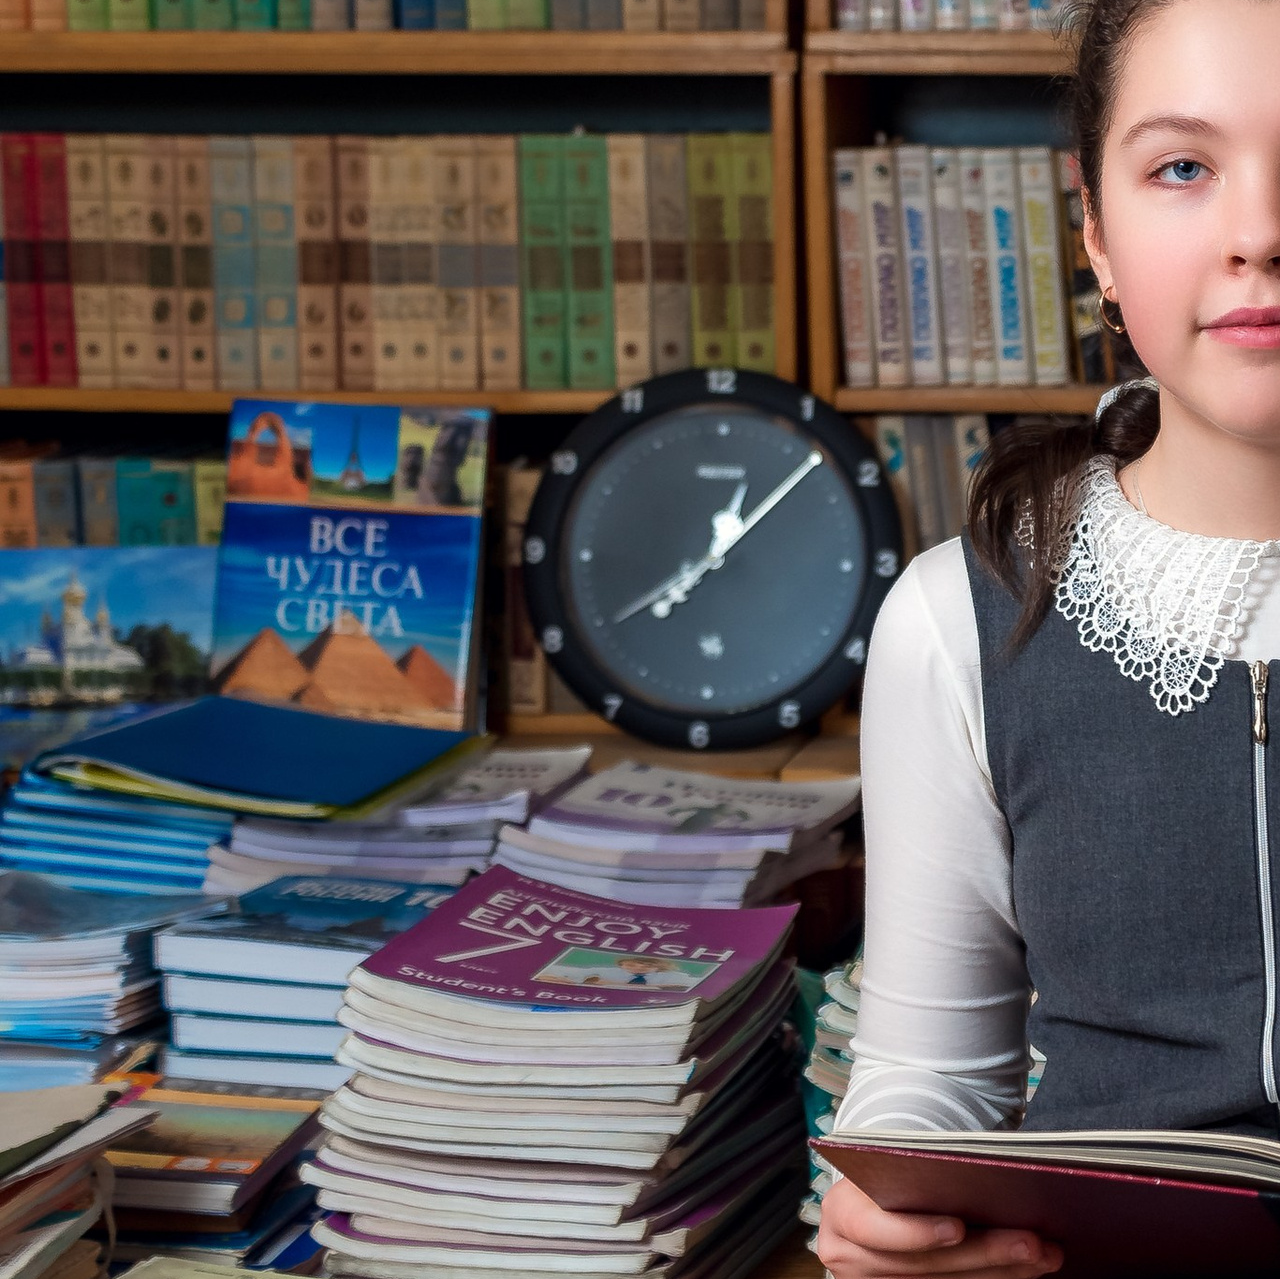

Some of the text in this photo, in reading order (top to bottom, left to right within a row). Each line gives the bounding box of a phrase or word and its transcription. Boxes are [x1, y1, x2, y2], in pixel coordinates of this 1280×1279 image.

[706, 370, 737, 393] 12
[622, 389, 643, 413] 11
[801, 397, 815, 420] 1
[552, 450, 578, 475] 10
[858, 460, 879, 487] 2
[310, 516, 389, 557] ВСЕ
[526, 537, 545, 564] 9
[876, 550, 897, 577] 3
[266, 555, 424, 599] ЧУДЕСА
[276, 598, 405, 637] СВЕТА
[543, 626, 563, 654] 8
[845, 638, 866, 664] 4
[603, 694, 624, 720] 7
[779, 701, 800, 728] 5
[689, 722, 709, 748] 6
[487, 890, 684, 939] ENJOY
[501, 889, 635, 922] АНГЛИЙСКИЙ
[640, 918, 691, 929] ЯЗЫК
[435, 921, 542, 963] 7
[468, 906, 736, 962] ENGLISH
[397, 966, 608, 1004] Student's Book
